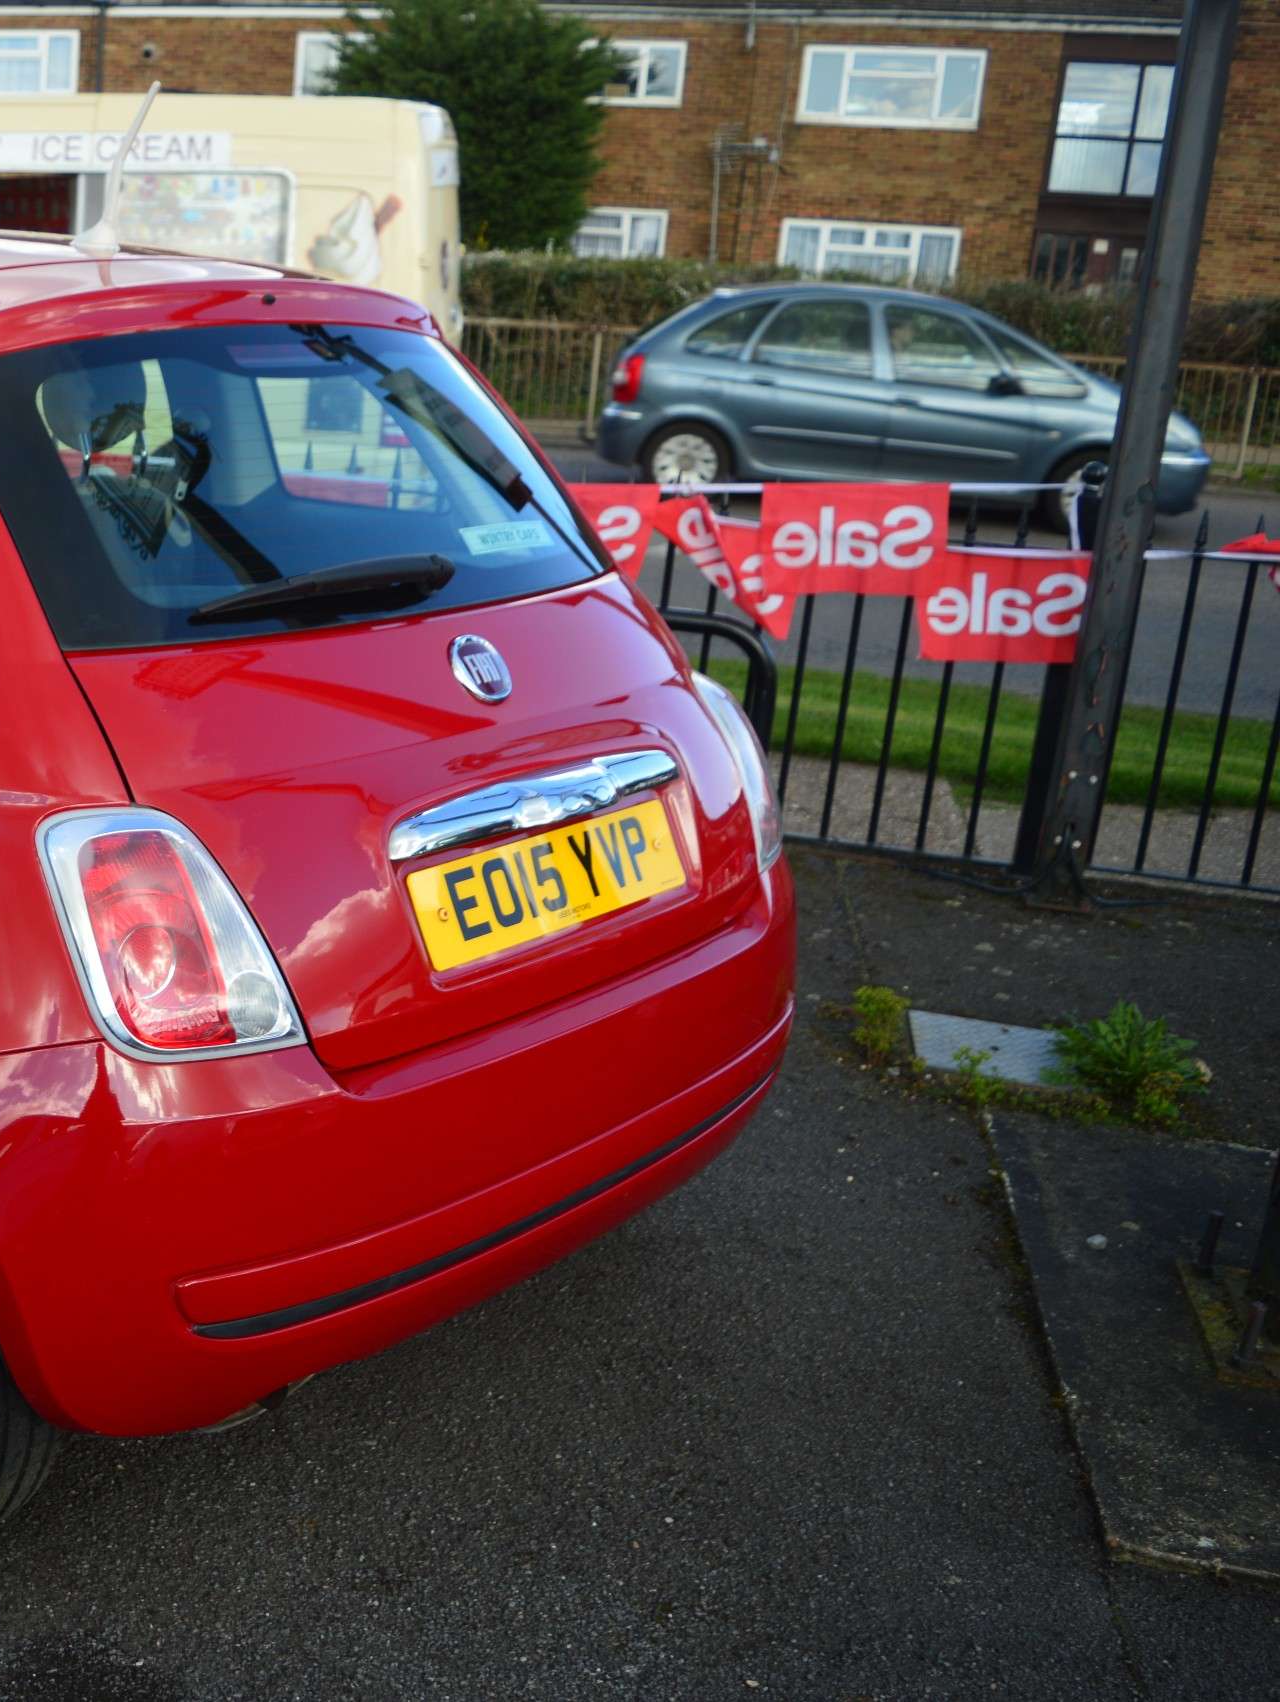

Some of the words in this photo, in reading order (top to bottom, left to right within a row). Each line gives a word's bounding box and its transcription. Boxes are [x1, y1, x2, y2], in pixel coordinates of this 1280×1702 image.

[31, 135, 81, 161] ICE
[95, 135, 213, 162] CREAM
[463, 652, 501, 685] FIAT
[443, 842, 568, 941] EO15
[568, 816, 647, 897] YVP
